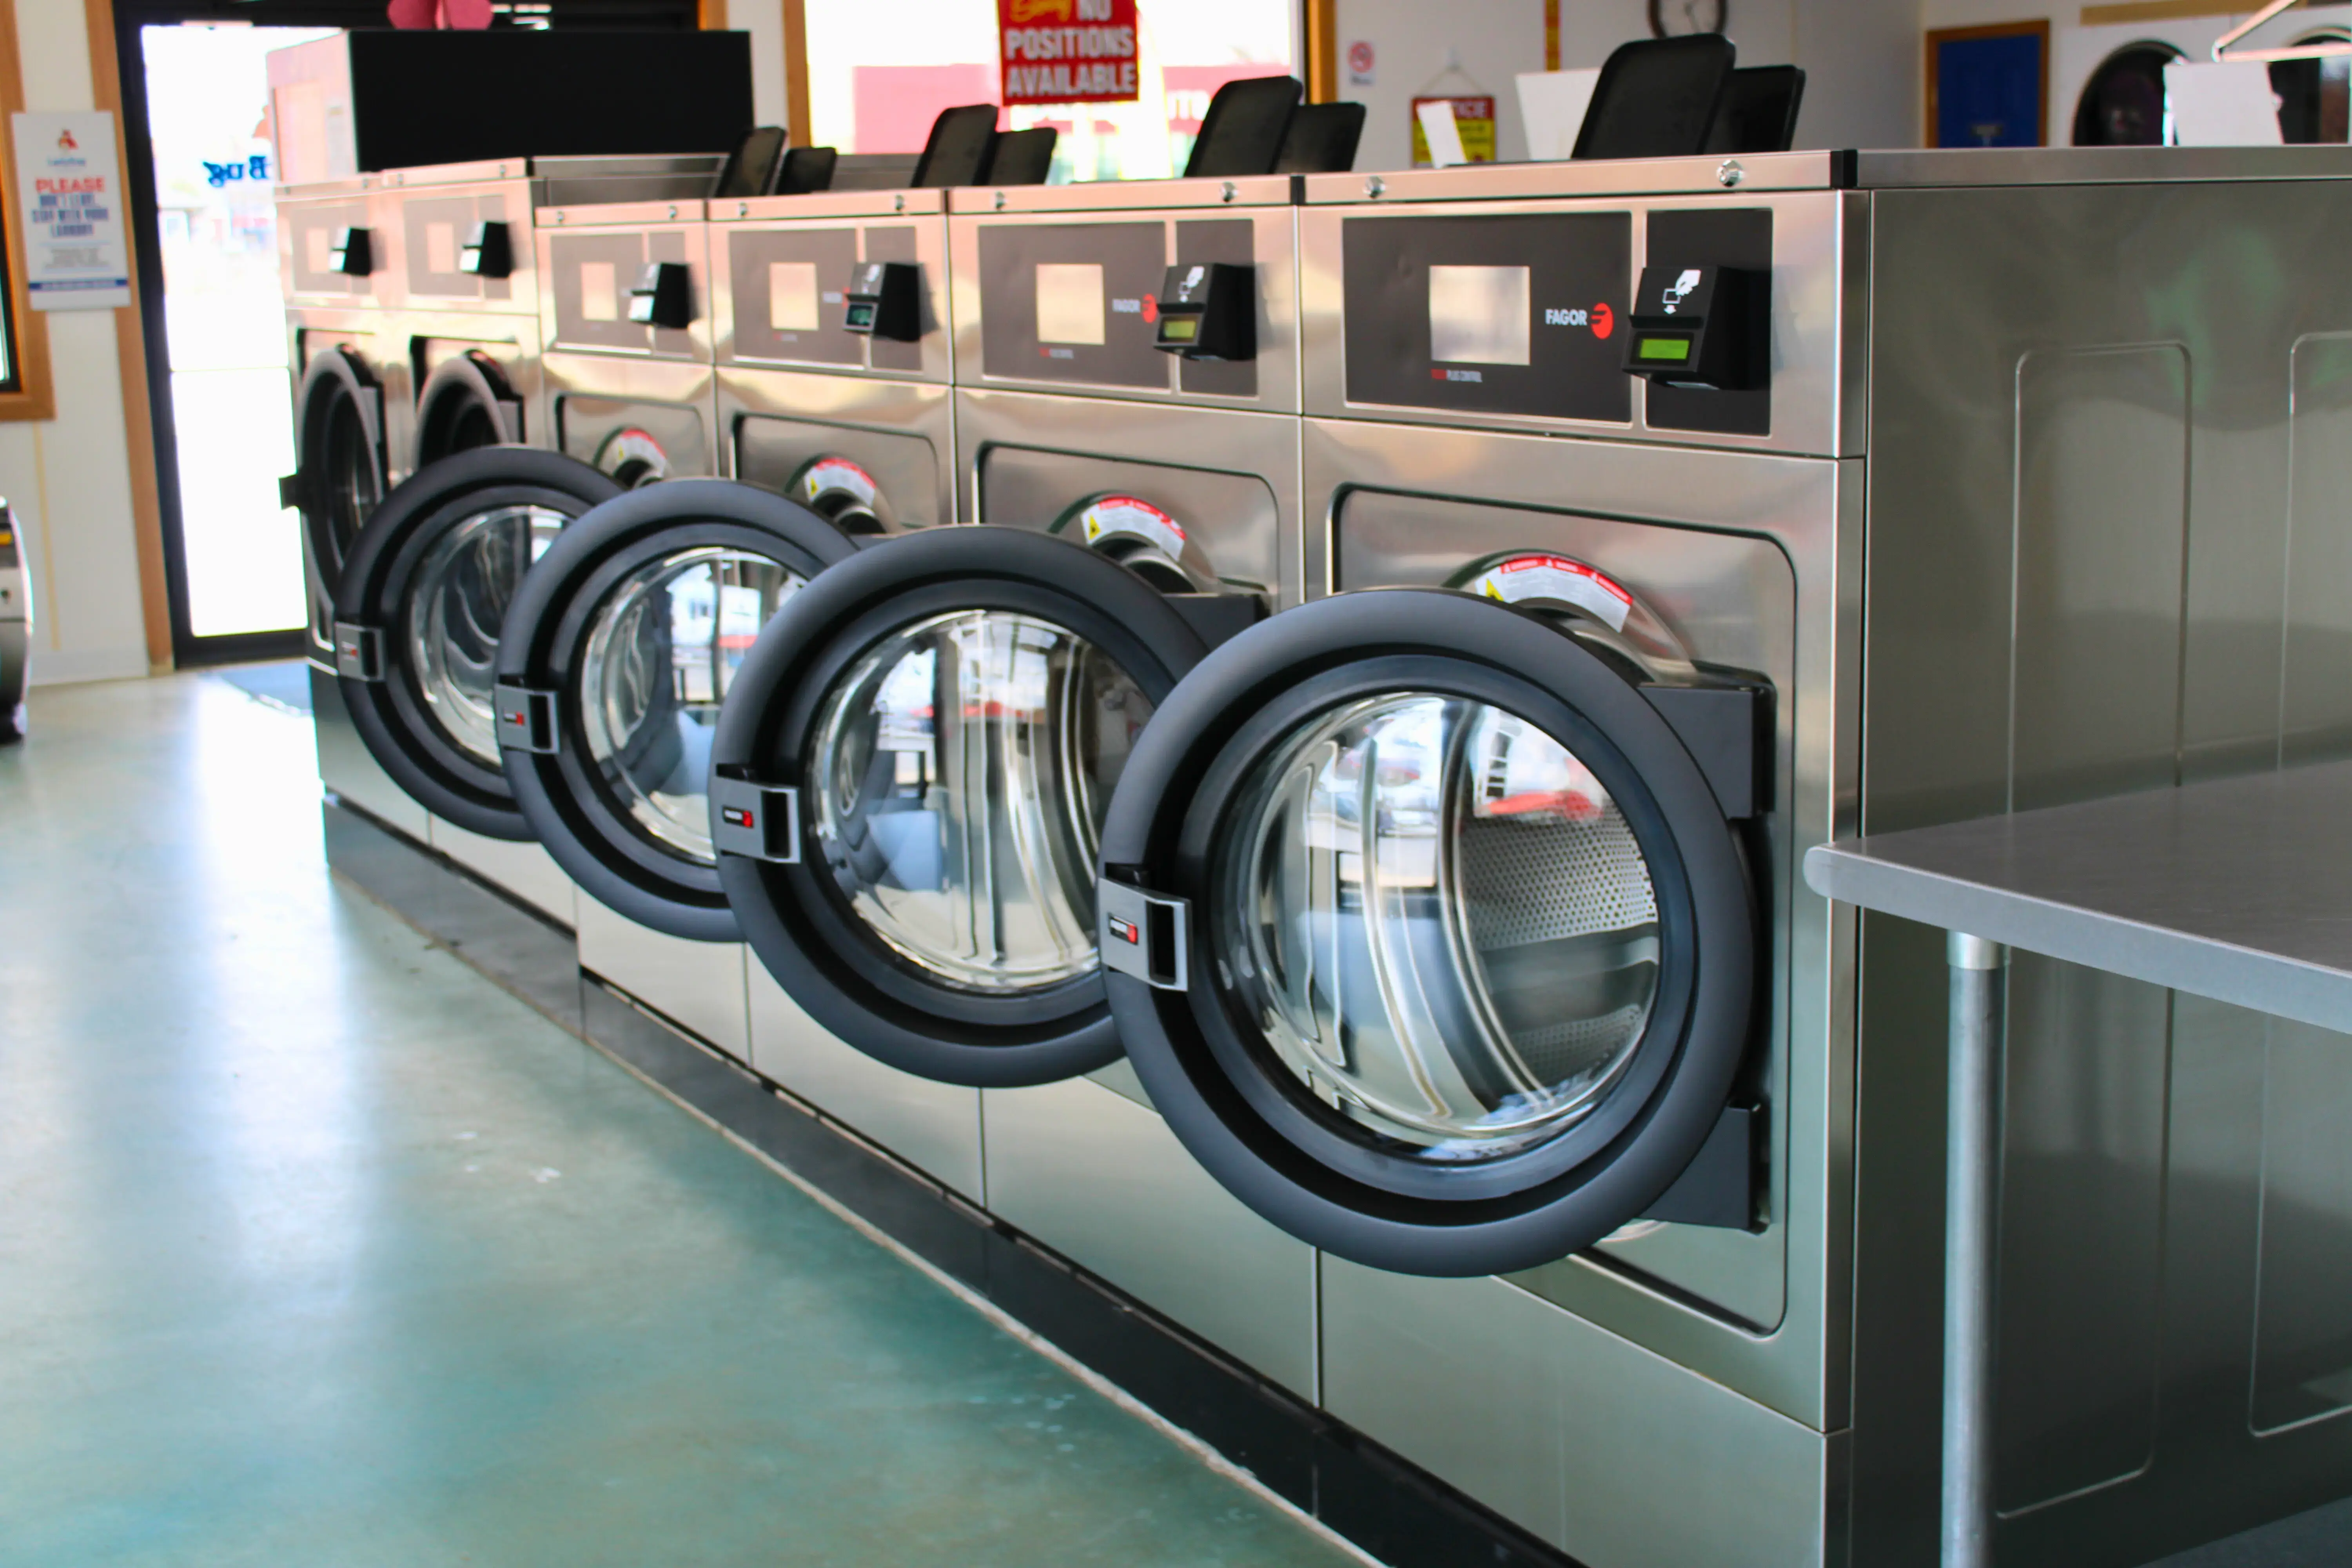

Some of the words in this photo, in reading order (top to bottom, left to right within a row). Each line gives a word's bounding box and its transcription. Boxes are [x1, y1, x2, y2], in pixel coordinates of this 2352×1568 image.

[1005, 24, 1135, 60] POSITIONS
[1004, 62, 1136, 98] AVAILABLE
[36, 177, 105, 194] PLEASE
[1545, 308, 1588, 326] FAGOR
